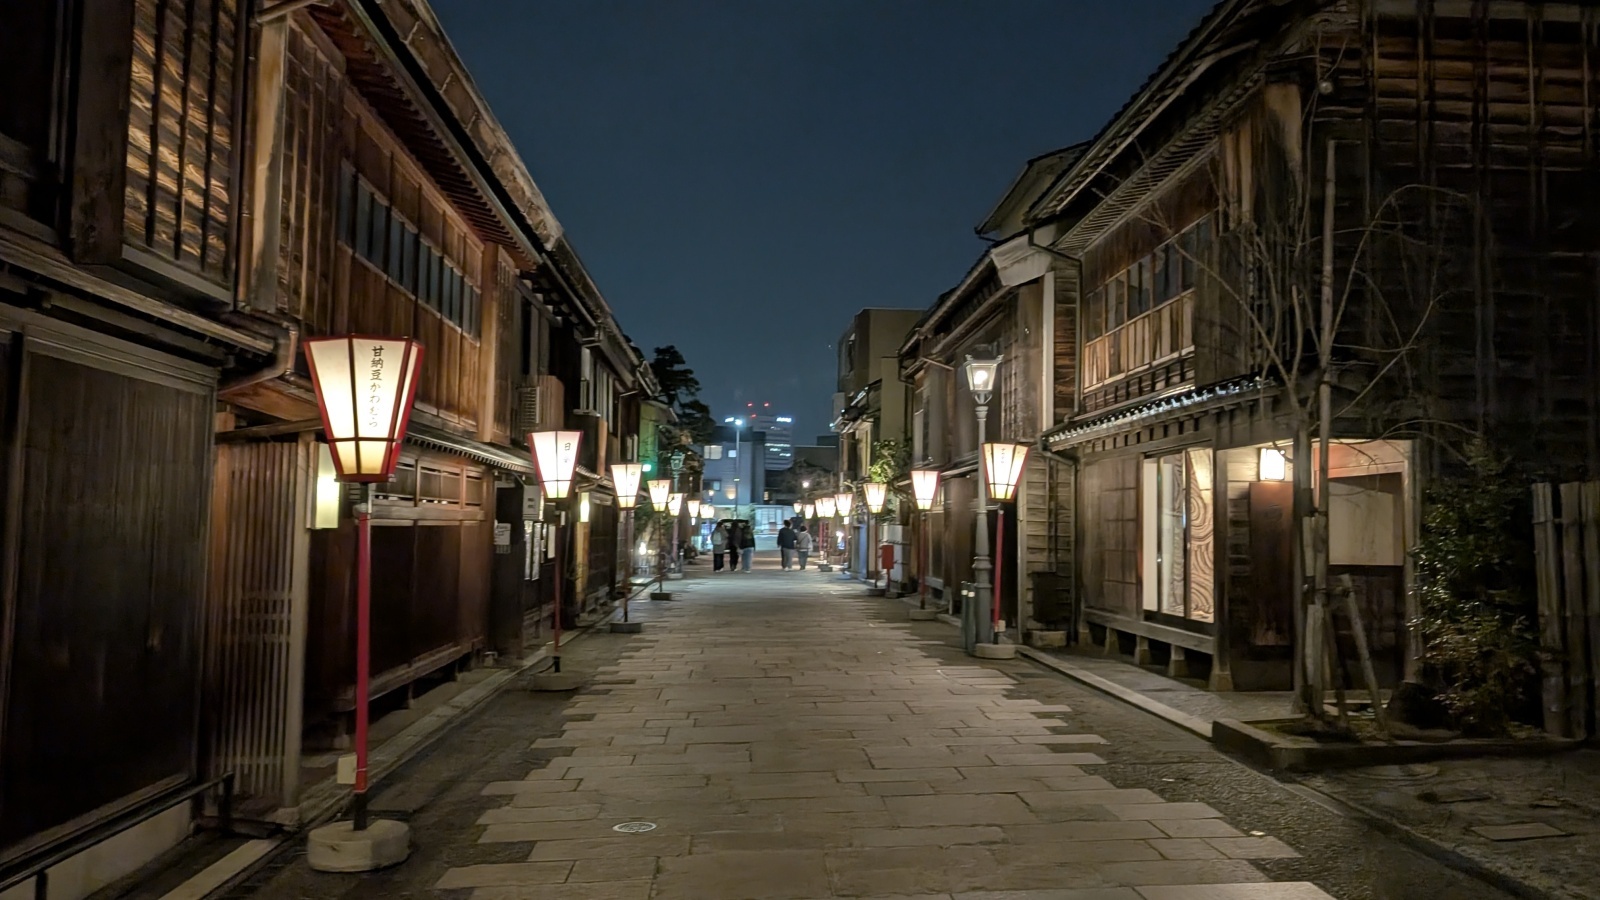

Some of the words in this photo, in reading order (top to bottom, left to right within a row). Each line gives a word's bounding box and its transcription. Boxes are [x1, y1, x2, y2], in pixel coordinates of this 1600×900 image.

[369, 345, 384, 428] 甘納豆かわむら
